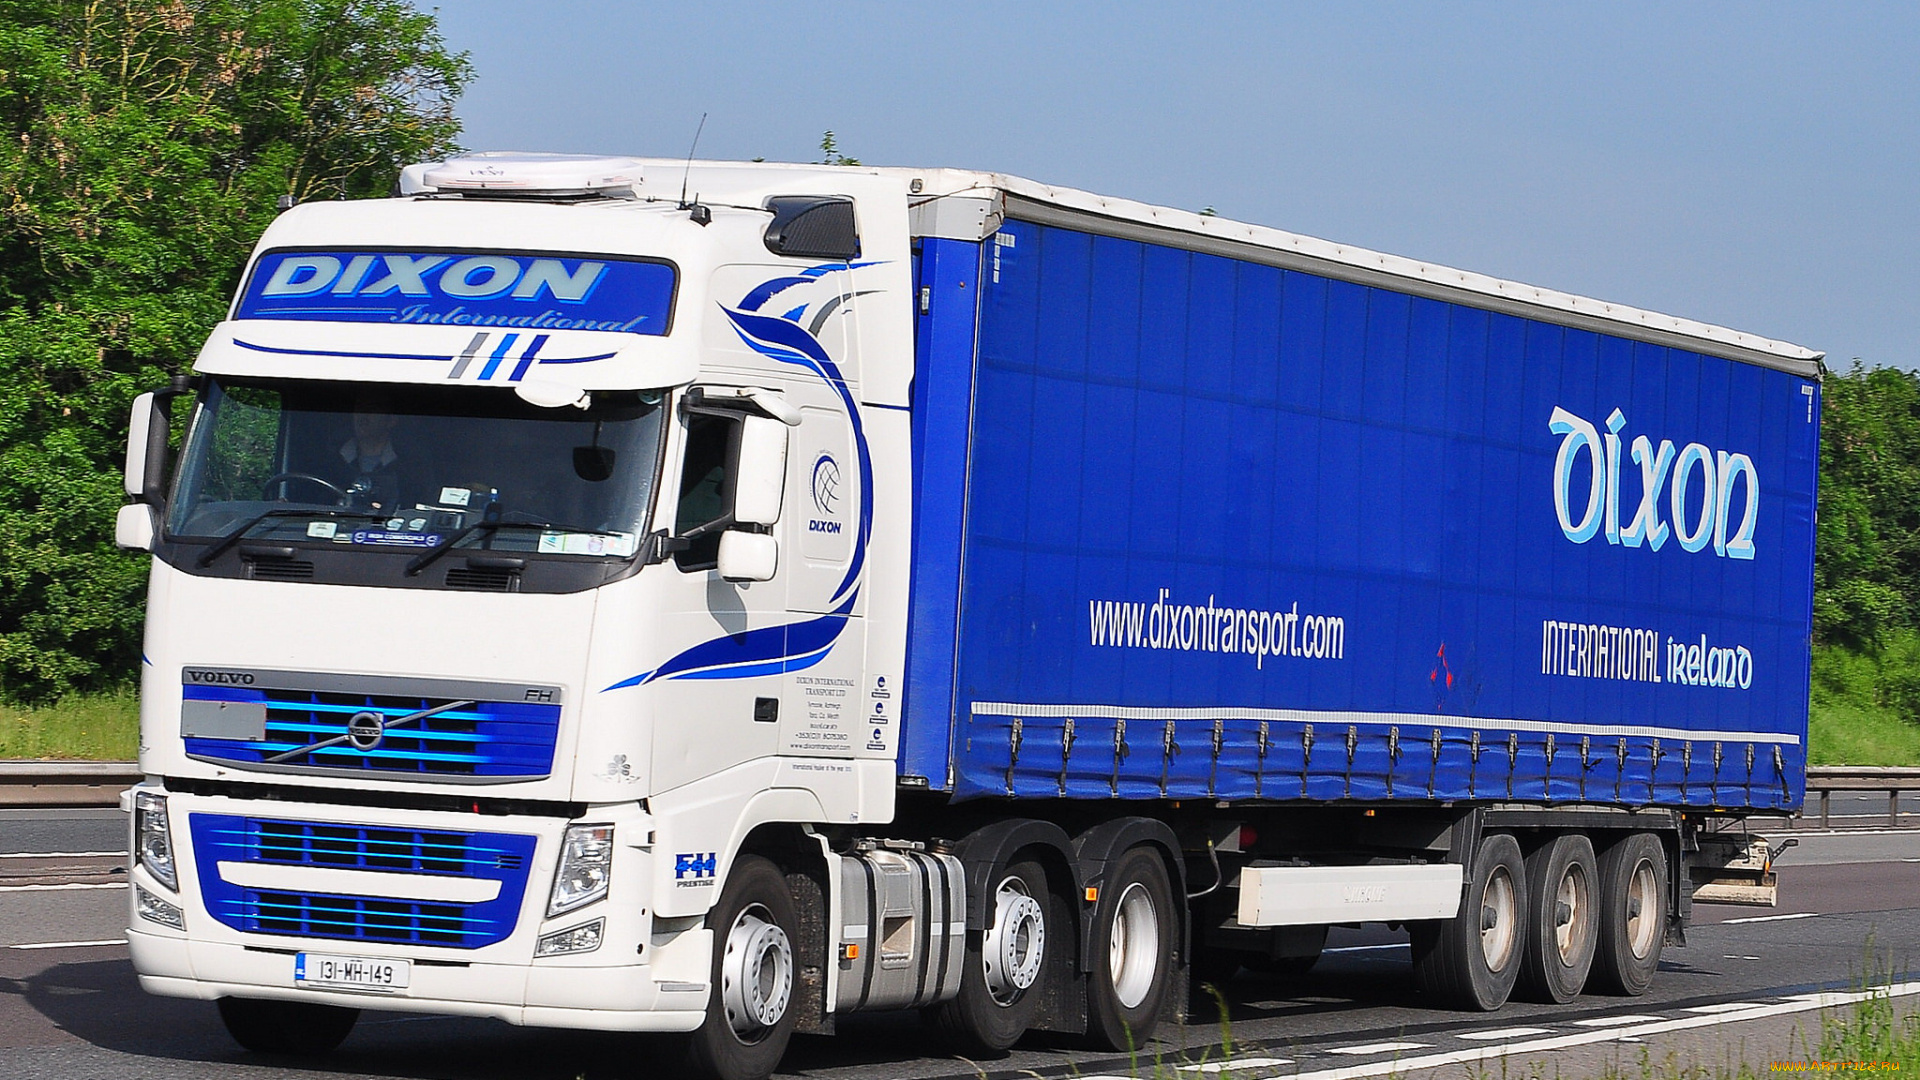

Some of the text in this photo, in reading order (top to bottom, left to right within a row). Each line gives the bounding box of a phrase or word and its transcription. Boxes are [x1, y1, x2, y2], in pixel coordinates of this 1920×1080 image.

[261, 255, 608, 303] DIXON
[390, 304, 648, 332] International
[809, 520, 841, 534] DIXON
[1089, 587, 1345, 670] www.dixontransport.com
[1541, 619, 1662, 683] INTERNATIONAL
[188, 671, 255, 685] VOLVO
[524, 689, 554, 702] FH
[320, 960, 393, 984] 131-MH-149
